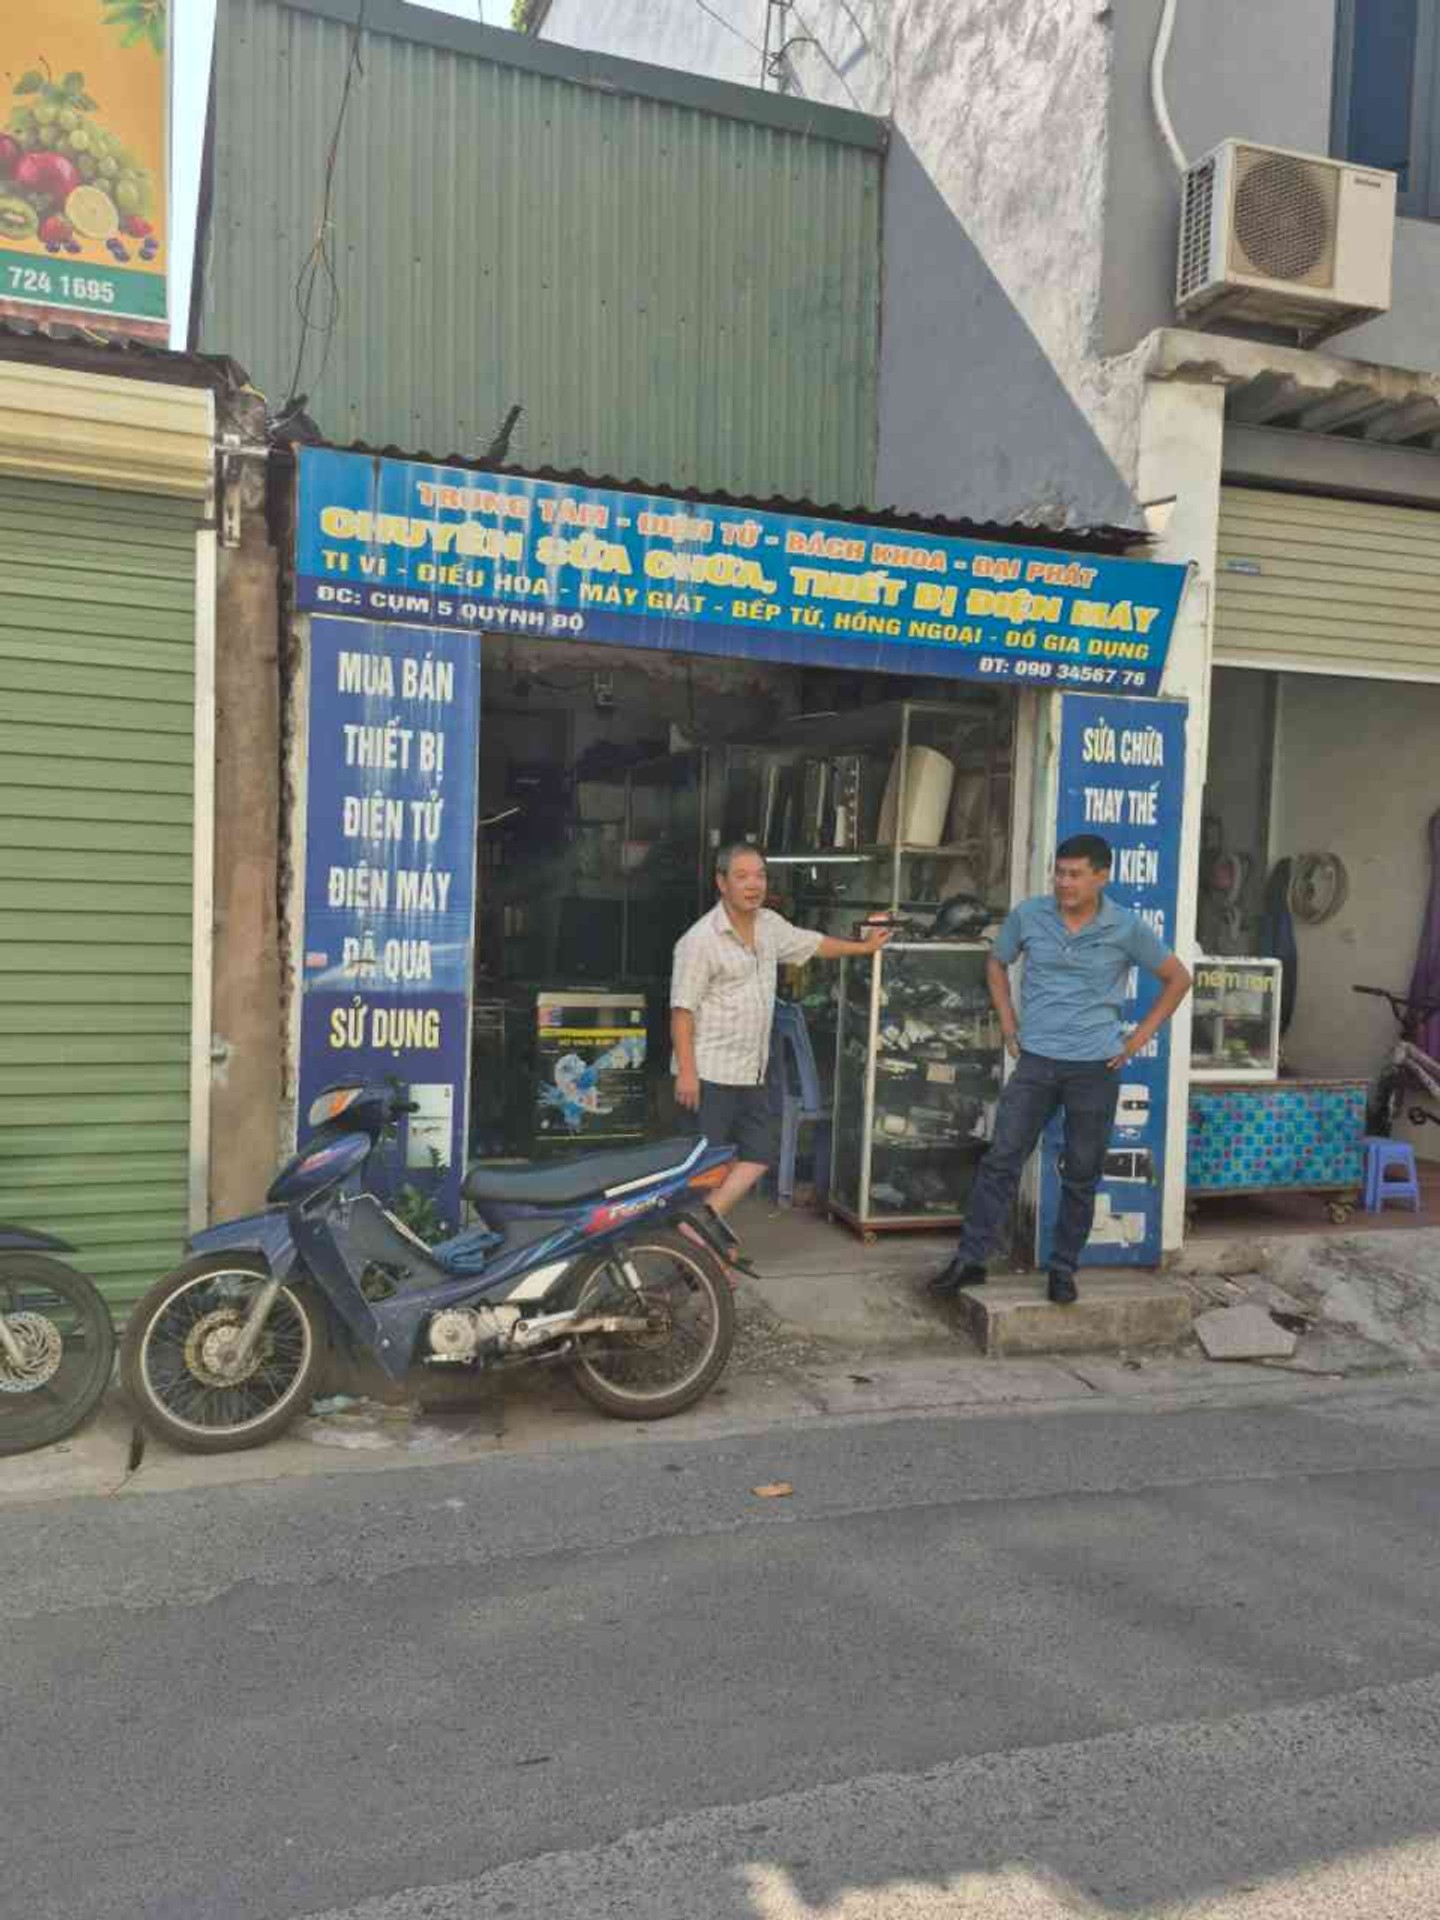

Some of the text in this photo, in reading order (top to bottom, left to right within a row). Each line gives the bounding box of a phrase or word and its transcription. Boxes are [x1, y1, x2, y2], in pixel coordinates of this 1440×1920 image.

[8, 266, 50, 293] 724
[416, 481, 530, 520] TRUNG
[785, 530, 866, 562] BÁCH
[870, 543, 947, 572] KHOA
[1026, 562, 1098, 589] PHÁT
[320, 506, 524, 560] CHUYÊN
[790, 567, 907, 606] THIẾT
[913, 582, 958, 618] BỊ
[966, 588, 1064, 625] ĐIỆN
[1070, 601, 1161, 634] MÁY
[317, 585, 361, 605] ĐC:
[370, 592, 429, 613] CỤM
[438, 601, 453, 615] 5
[322, 550, 349, 571] TI
[580, 582, 638, 606] MÁY
[732, 598, 781, 622] BẾP
[908, 620, 983, 645] NGOẠI
[1044, 634, 1080, 653] GIA
[1087, 639, 1149, 661] DỤNG
[338, 651, 453, 702] MUA BÁN
[979, 656, 1009, 673] ĐT:
[1014, 660, 1051, 677] 090
[1056, 664, 1117, 685] 34567
[343, 715, 444, 781] THIẾT BỊ
[1082, 717, 1164, 767] SỬA CHỮA
[343, 786, 444, 847] ĐIỆN TỬ
[1084, 780, 1161, 826] THAY THẾ
[328, 861, 451, 917] ĐIỆN MÁY
[1119, 842, 1158, 891] KIỆN
[384, 938, 432, 982] QUA
[329, 995, 441, 1057] SỬ DỤNG
